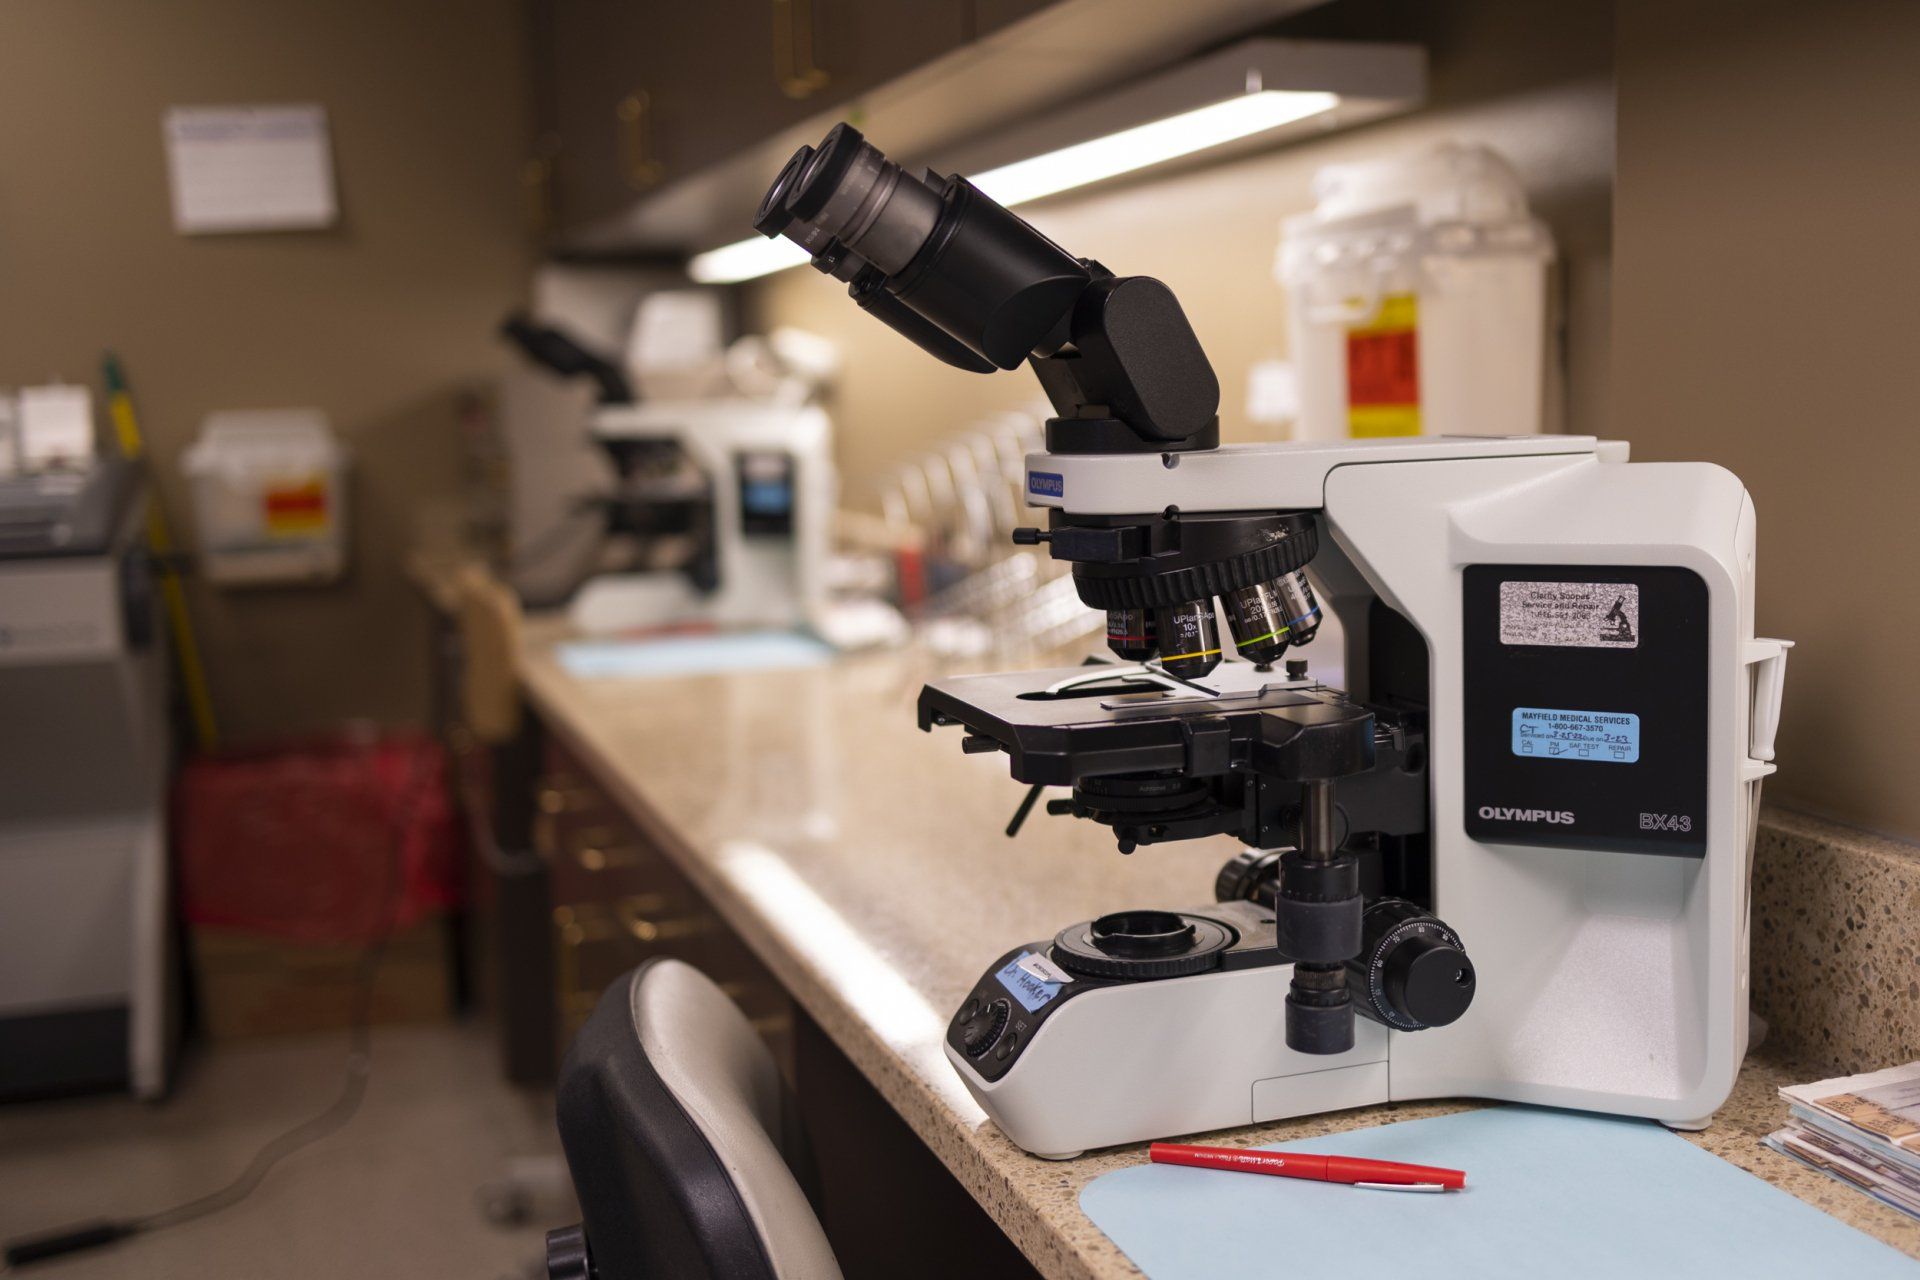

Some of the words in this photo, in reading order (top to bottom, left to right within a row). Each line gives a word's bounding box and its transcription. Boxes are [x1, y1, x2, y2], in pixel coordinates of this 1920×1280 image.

[1032, 477, 1062, 491] OLYMPUS
[1560, 592, 1591, 601] Scopes
[1522, 601, 1553, 610] Service
[1554, 602, 1570, 610] and
[1571, 602, 1600, 611] Repair
[1522, 711, 1558, 721] MAYFIELD
[1559, 714, 1592, 723] MEDICAL
[1594, 716, 1631, 725] SERVICES
[1548, 723, 1604, 732] 1-800-667-3570
[1478, 806, 1575, 825] OLYMPUS
[1639, 812, 1692, 832] BX43
[1016, 971, 1051, 1002] Hooker
